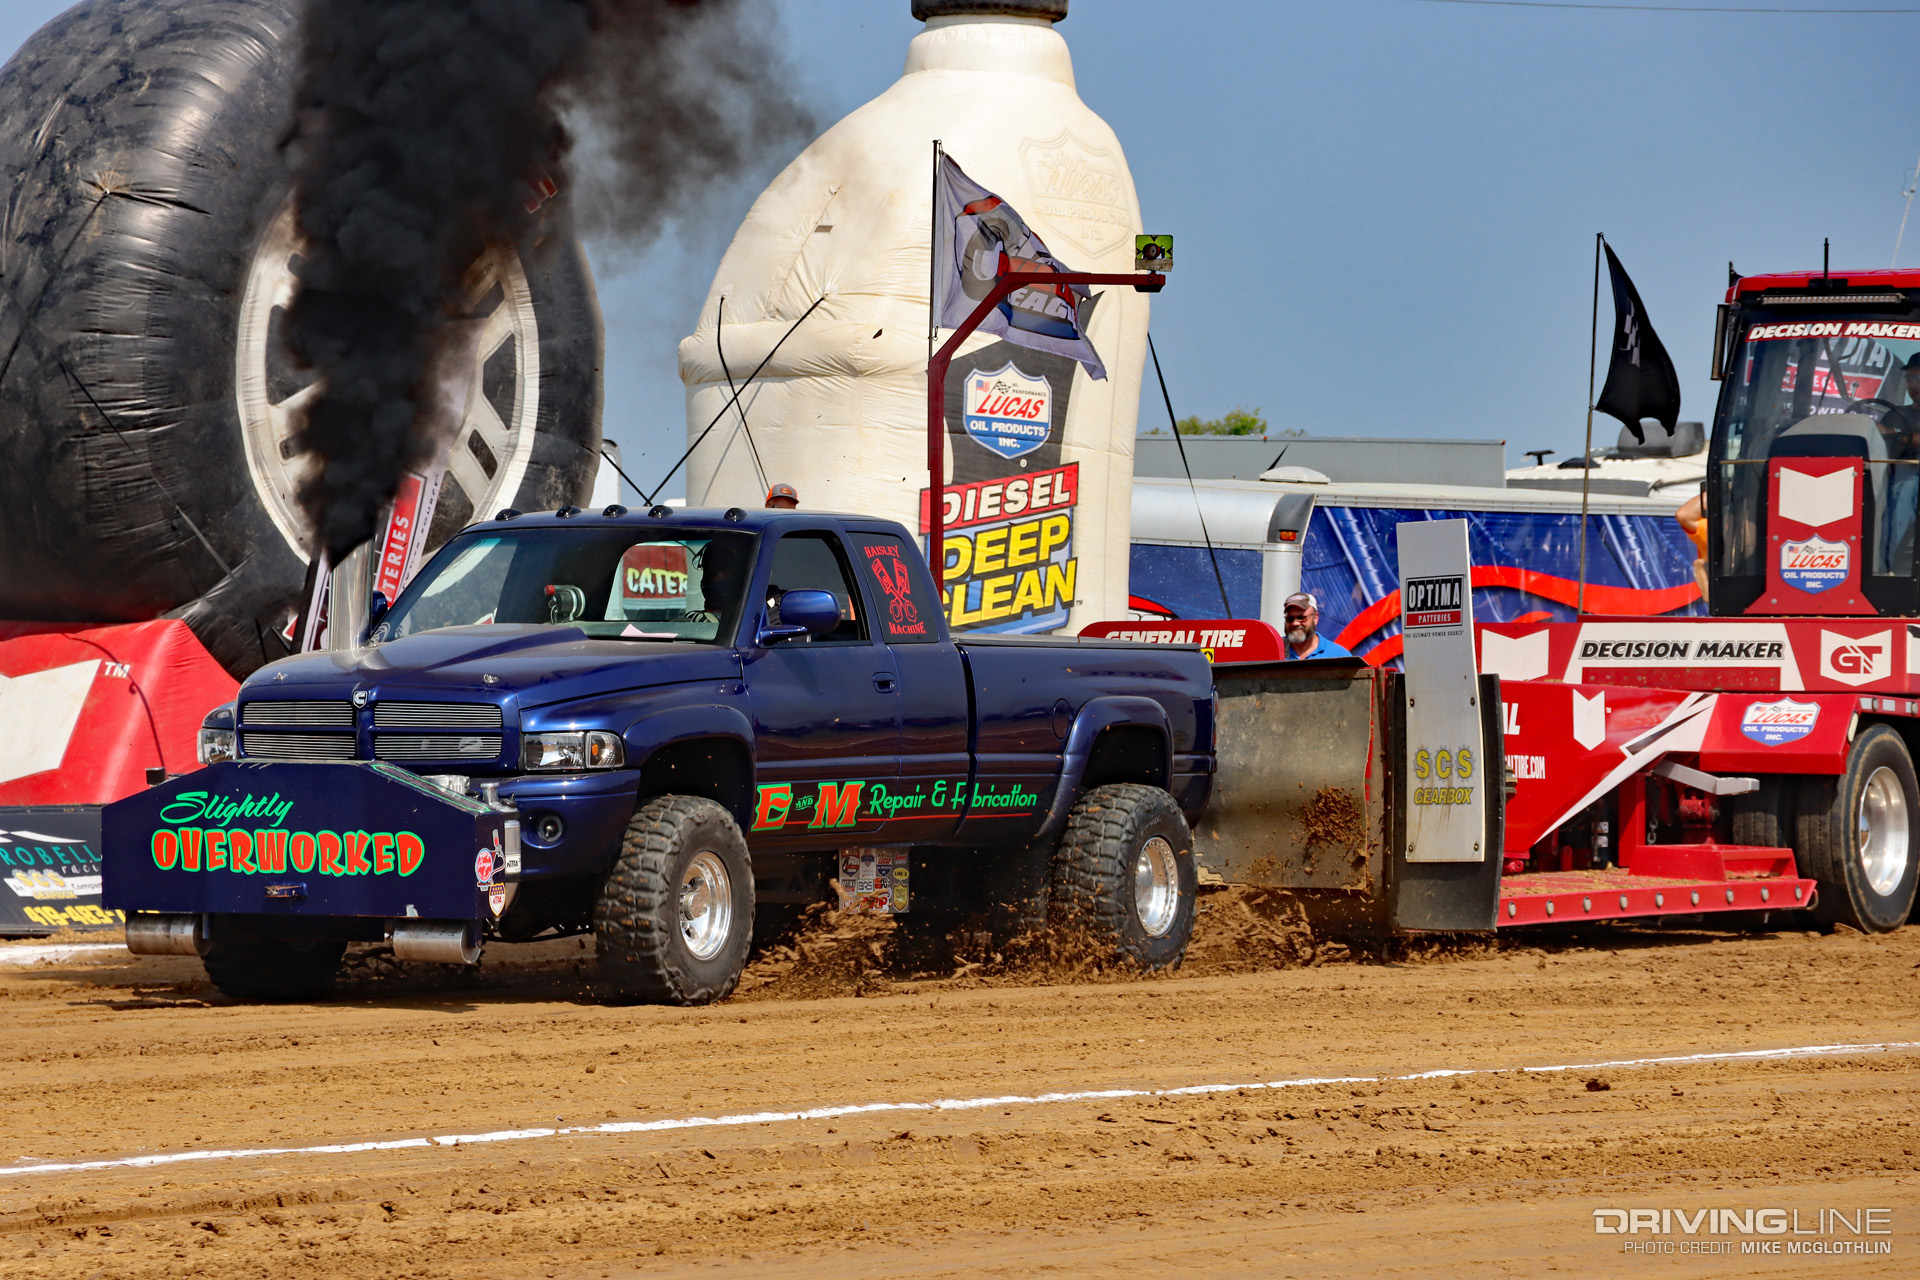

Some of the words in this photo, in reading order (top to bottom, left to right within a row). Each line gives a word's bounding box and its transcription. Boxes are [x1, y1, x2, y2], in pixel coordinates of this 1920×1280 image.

[1749, 322, 1842, 340] DECISION
[1844, 322, 1920, 339] MAKER
[975, 394, 1045, 419] LUCAS
[970, 420, 989, 431] OIL
[991, 421, 1046, 437] PRODUCTS
[998, 437, 1021, 448] INC.
[943, 471, 1072, 526] DIESEL
[863, 544, 900, 559] HAISLEY
[943, 515, 1070, 581] DEEP
[1788, 554, 1845, 569] LUCAS
[1783, 571, 1799, 579] OIL
[1800, 571, 1846, 579] PRODUCTS
[1408, 582, 1460, 609] OPTIMA
[888, 621, 927, 635] MACHINE
[1199, 629, 1246, 648] TIRE
[1580, 641, 1690, 660] DECISION
[1698, 641, 1785, 660] MAKER
[104, 661, 131, 678] TM
[1751, 712, 1813, 724] LUCAS
[1416, 748, 1473, 779] SCS
[1414, 787, 1474, 805] GEARBOX
[160, 791, 293, 827] Slightly
[751, 783, 793, 831] E
[807, 781, 865, 829] M
[869, 784, 926, 818] Repair
[931, 780, 947, 807] &
[151, 827, 425, 877] OVERWORKED
[14, 871, 65, 888] SCS
